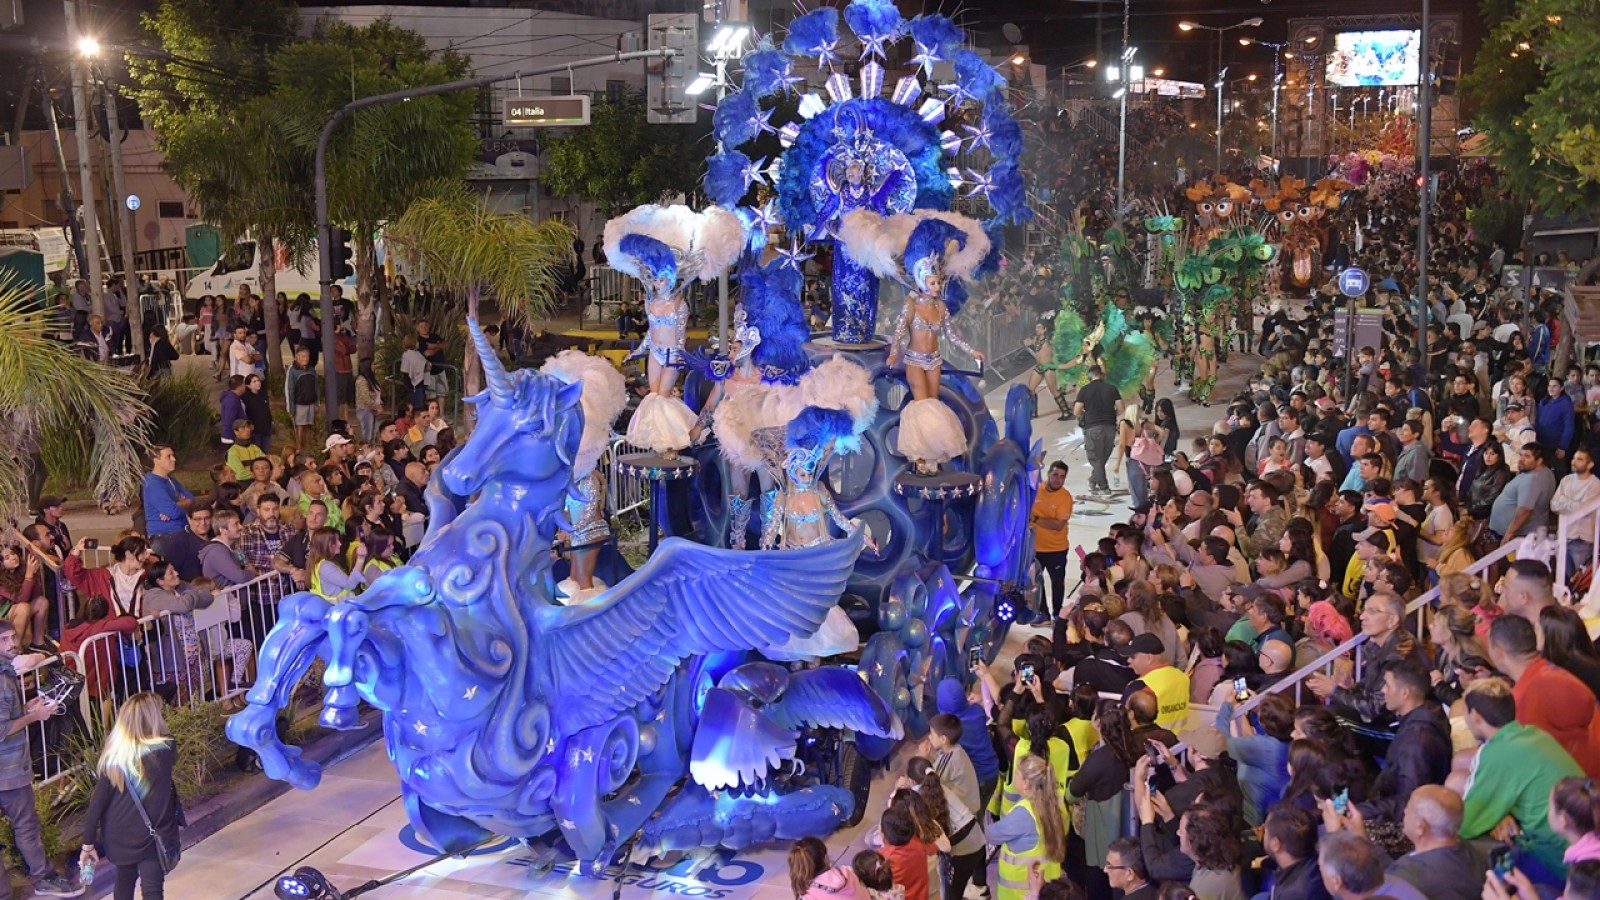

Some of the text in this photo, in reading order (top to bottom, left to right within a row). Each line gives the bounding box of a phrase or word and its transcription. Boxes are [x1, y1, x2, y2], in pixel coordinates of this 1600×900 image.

[510, 106, 545, 116] 04 Italia
[204, 281, 212, 290] 14
